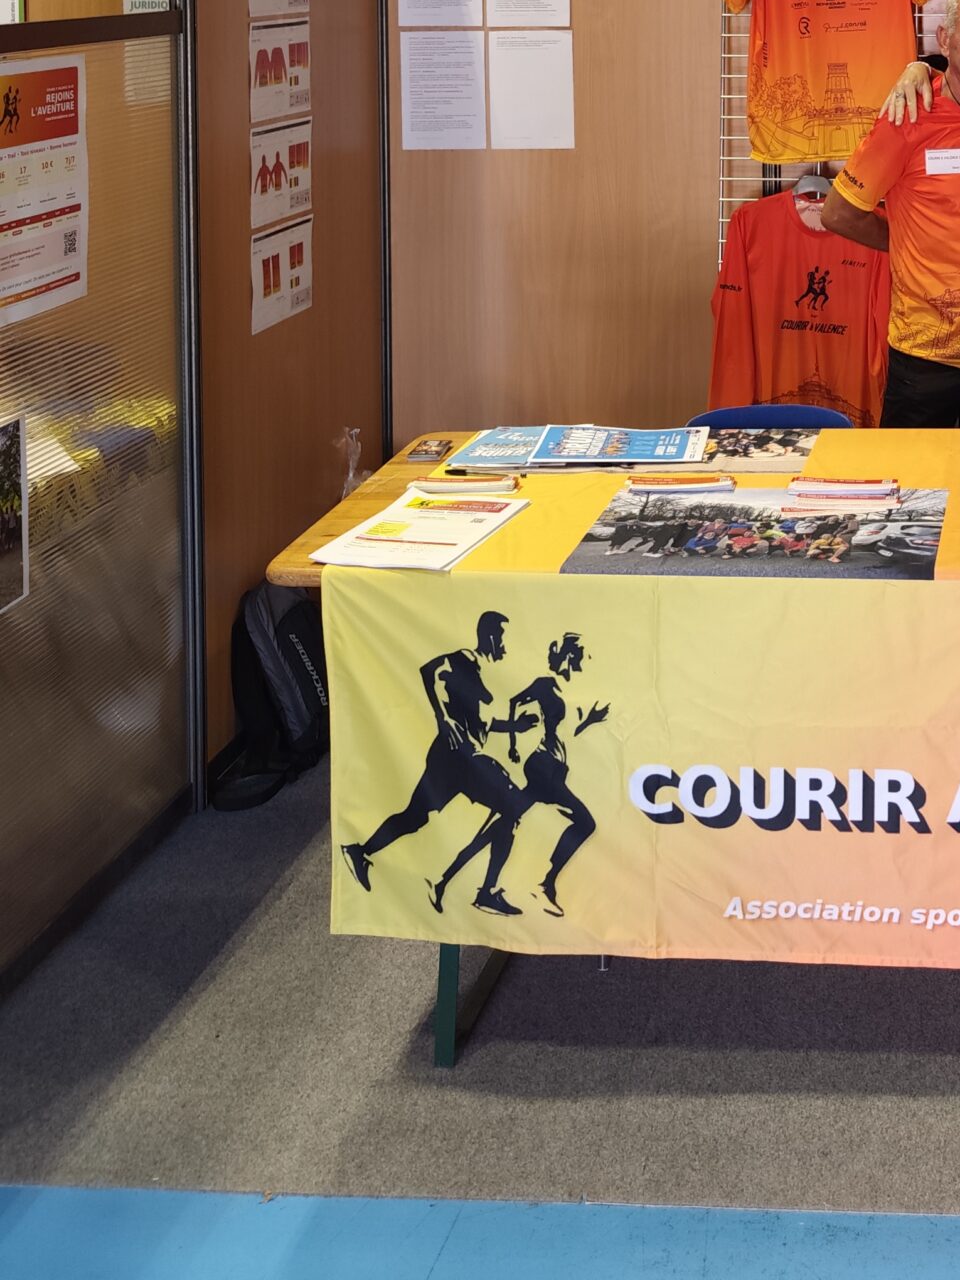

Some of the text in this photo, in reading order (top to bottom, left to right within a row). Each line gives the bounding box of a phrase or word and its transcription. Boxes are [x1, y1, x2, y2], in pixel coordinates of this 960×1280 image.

[45, 90, 74, 104] REJOINS
[780, 319, 809, 331] COURIR
[814, 321, 848, 335] VALENCE
[288, 633, 328, 706] ROCKRIDER
[628, 764, 932, 834] COURIR
[723, 896, 900, 925] Association
